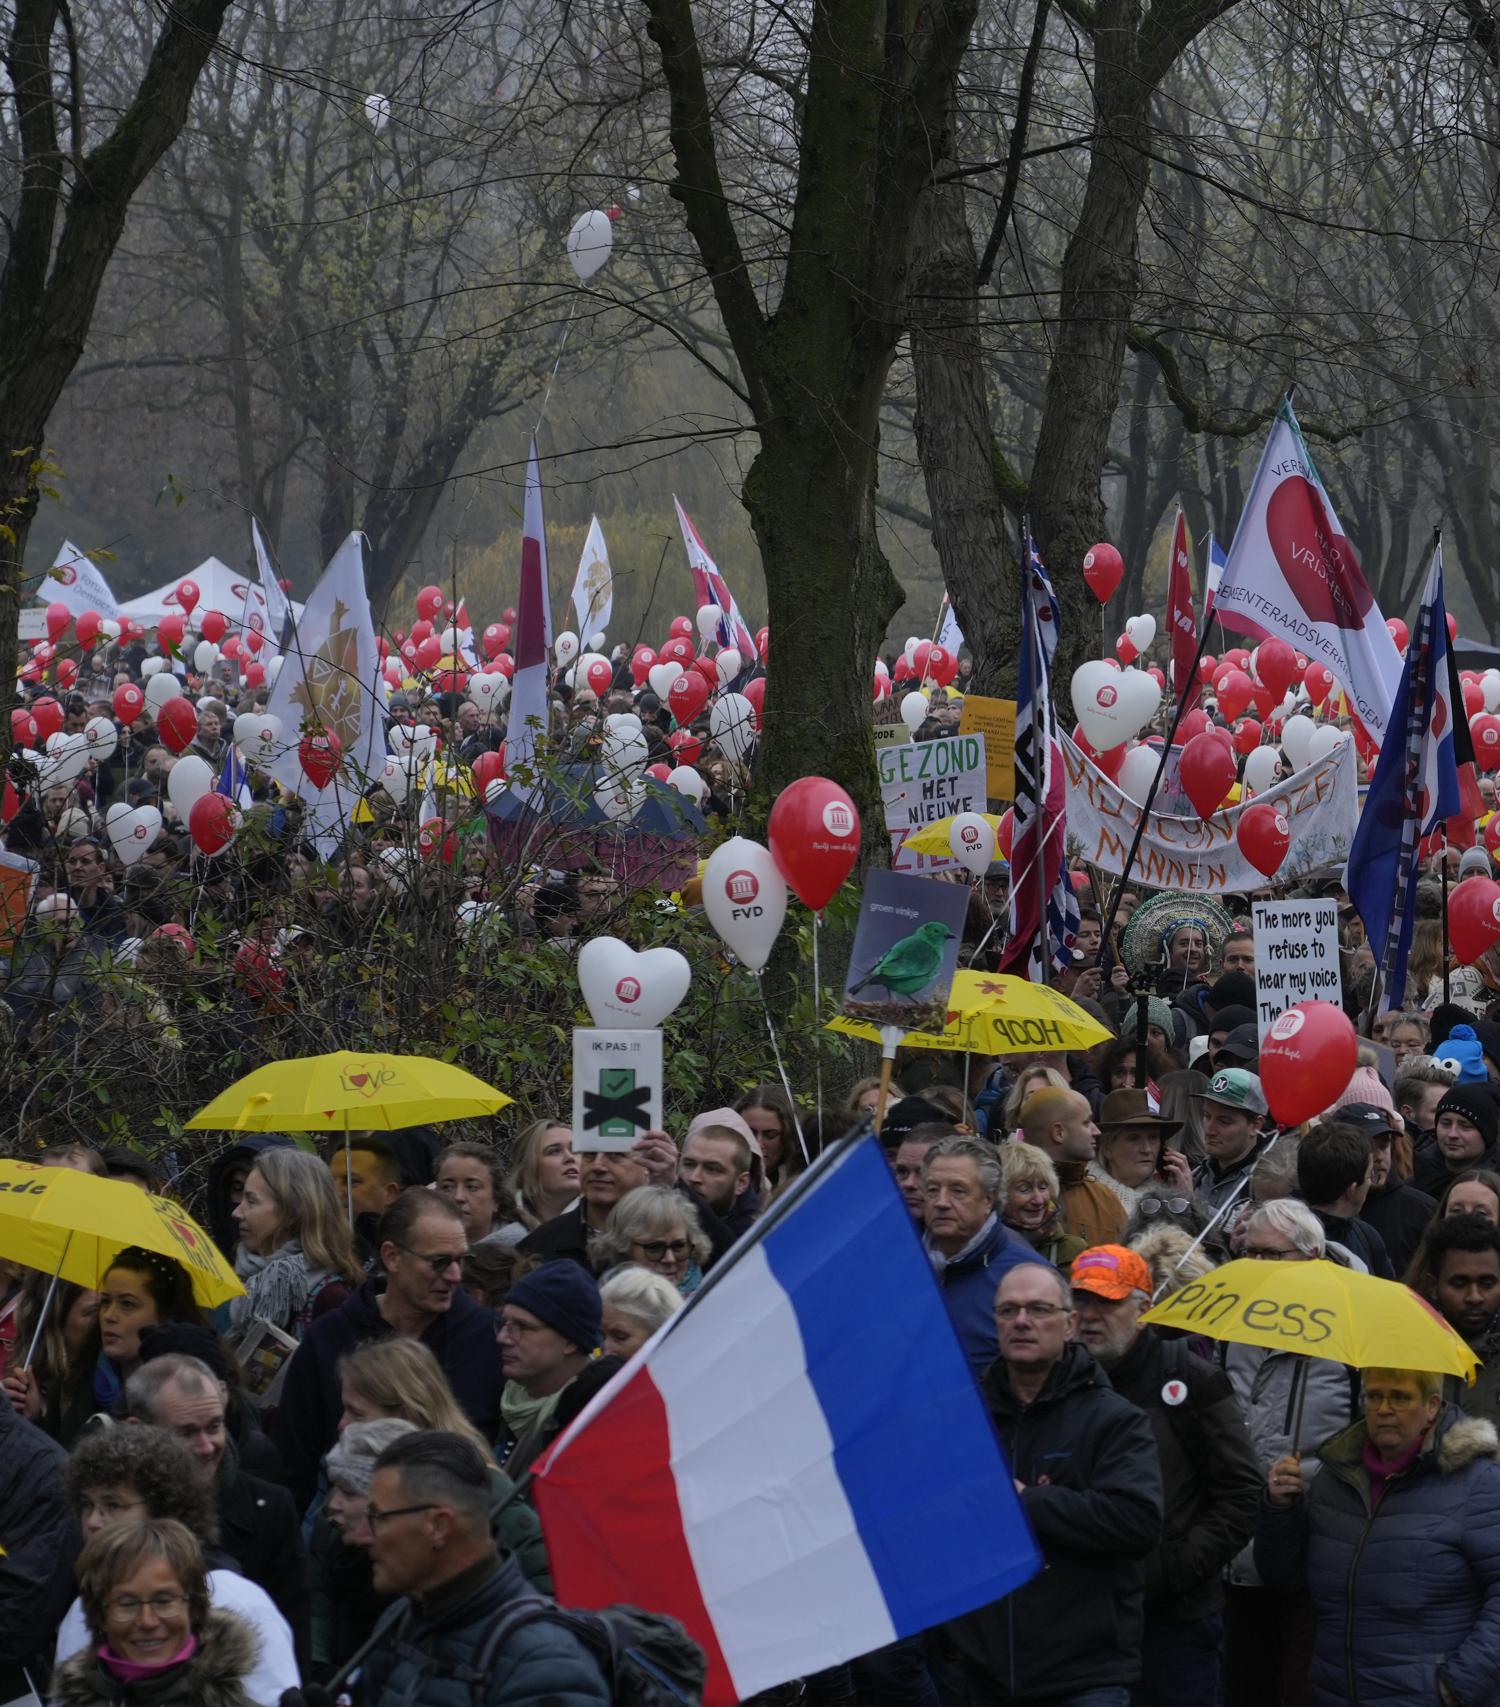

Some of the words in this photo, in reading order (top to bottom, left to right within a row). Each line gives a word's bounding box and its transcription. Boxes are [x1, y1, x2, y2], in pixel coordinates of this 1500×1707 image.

[880, 738, 979, 783] GEZOND
[922, 776, 958, 800] HET
[908, 796, 973, 824] NIEUWE
[966, 843, 982, 853] FVD
[732, 906, 763, 920] FVD
[869, 902, 894, 915] groen
[1255, 909, 1279, 929] The
[1282, 911, 1312, 928] more
[1315, 910, 1335, 934] you
[1268, 939, 1309, 960] refuse
[1311, 938, 1325, 958] to
[1258, 969, 1287, 989] hear
[1290, 971, 1306, 994] my
[1309, 968, 1338, 987] voice
[1260, 1001, 1282, 1022] The
[592, 1043, 602, 1051] IK
[605, 1043, 627, 1051] PAS
